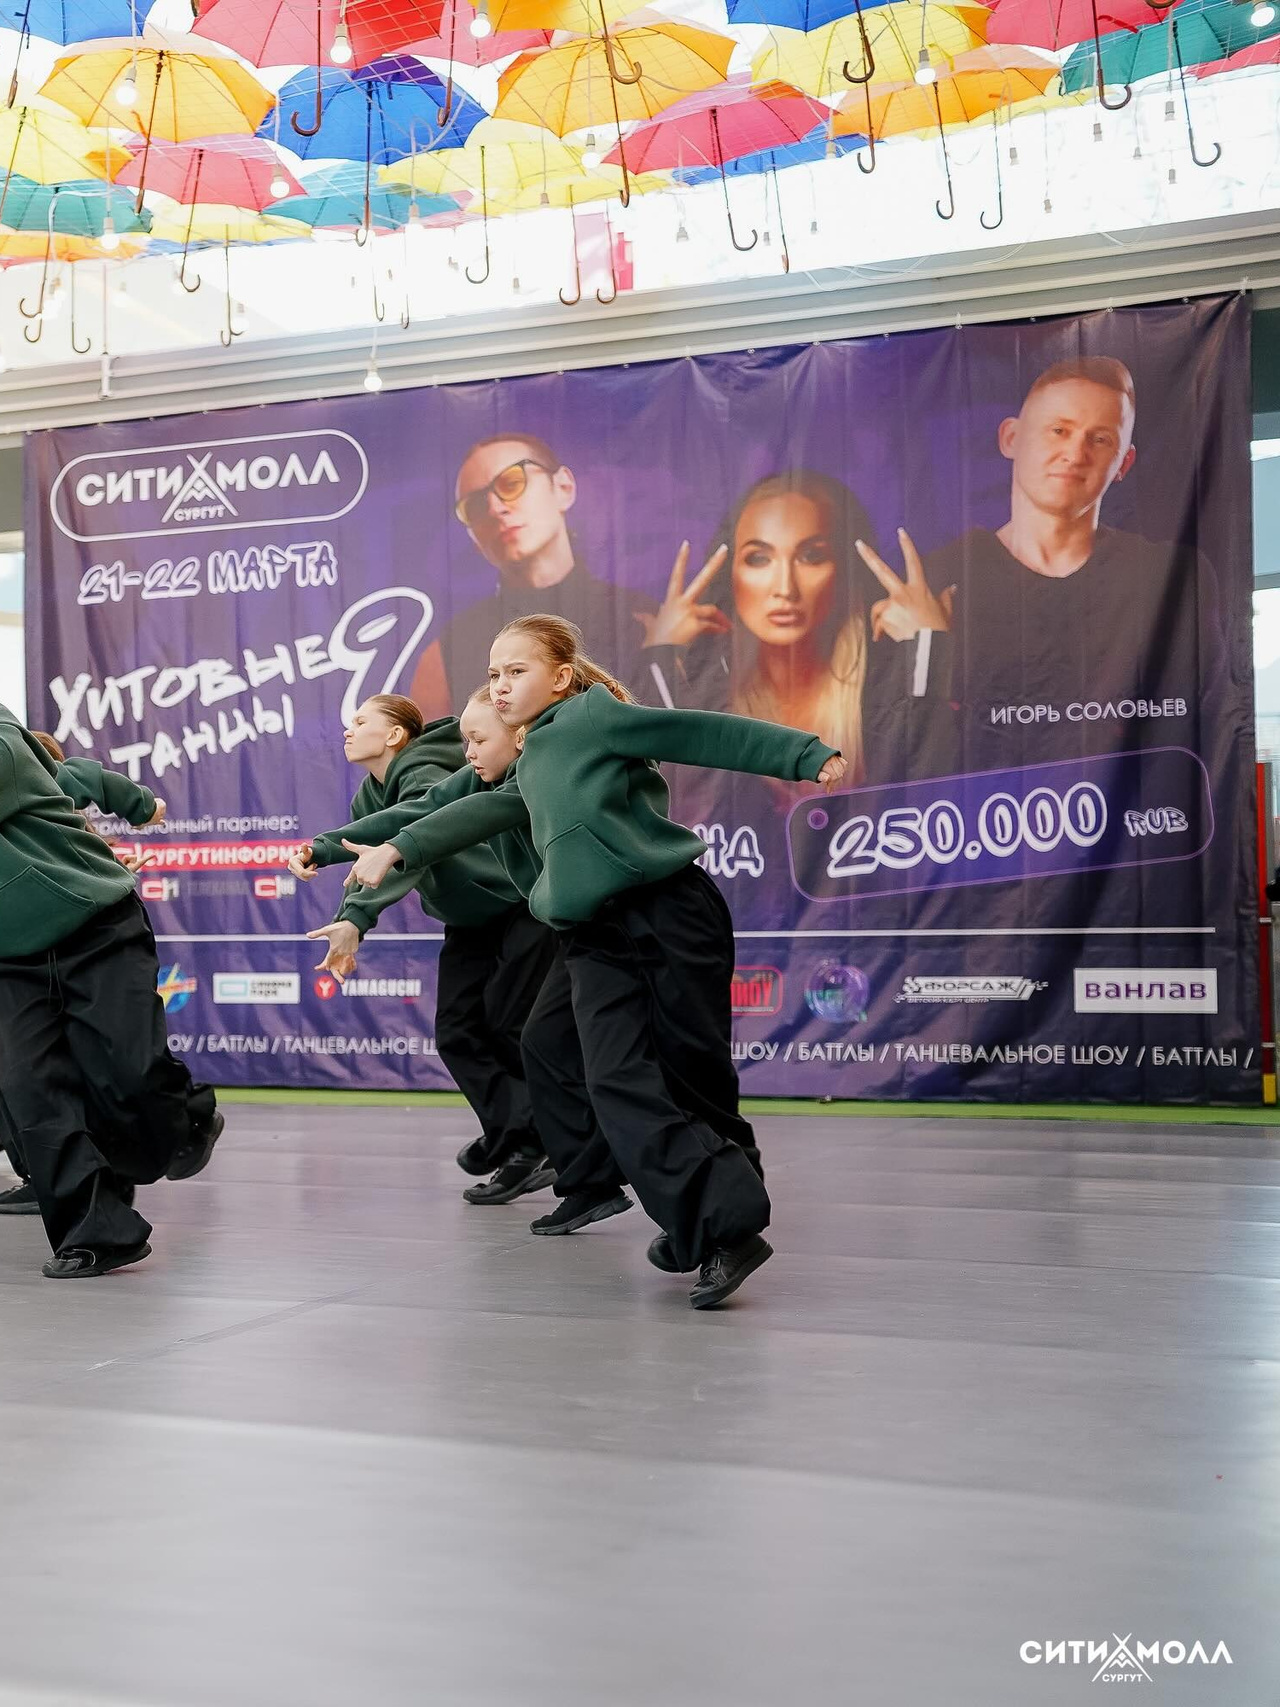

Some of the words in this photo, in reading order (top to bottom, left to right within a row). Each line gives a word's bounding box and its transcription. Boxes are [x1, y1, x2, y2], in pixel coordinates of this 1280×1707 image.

[76, 464, 183, 506] СИТИ
[215, 450, 340, 493] МОЛЛ
[173, 505, 226, 521] СУРГУТ
[77, 555, 202, 606] 21-22
[207, 540, 339, 594] МАРТА
[49, 634, 340, 749] ХИТОВЫЕ
[990, 703, 1061, 725] ИГОРЬ
[1065, 697, 1188, 722] СОЛОВЬЕВ
[110, 694, 295, 782] ТАНЦЫ
[217, 813, 300, 834] партнер:
[826, 781, 1108, 878] 250.000
[1124, 806, 1189, 838] RUB
[143, 844, 302, 868] СУРГУТИНФОРМ
[341, 978, 422, 997] YAMAGUCHI
[924, 981, 1017, 993] ФОРСАЖ
[1085, 982, 1207, 999] ванлав
[167, 1033, 194, 1053] ОУ
[207, 1034, 269, 1053] БАТТЛЫ
[283, 1034, 418, 1056] ТАНЦЕВАЛЬНОЕ
[731, 1041, 778, 1060] ШОУ
[798, 1042, 874, 1062] БАТТЛЫ
[895, 1043, 1065, 1065] ТАНЦЕВАЛЬНОЕ
[1071, 1044, 1129, 1066] ШОУ
[1152, 1046, 1238, 1067] БАТТЛЫ
